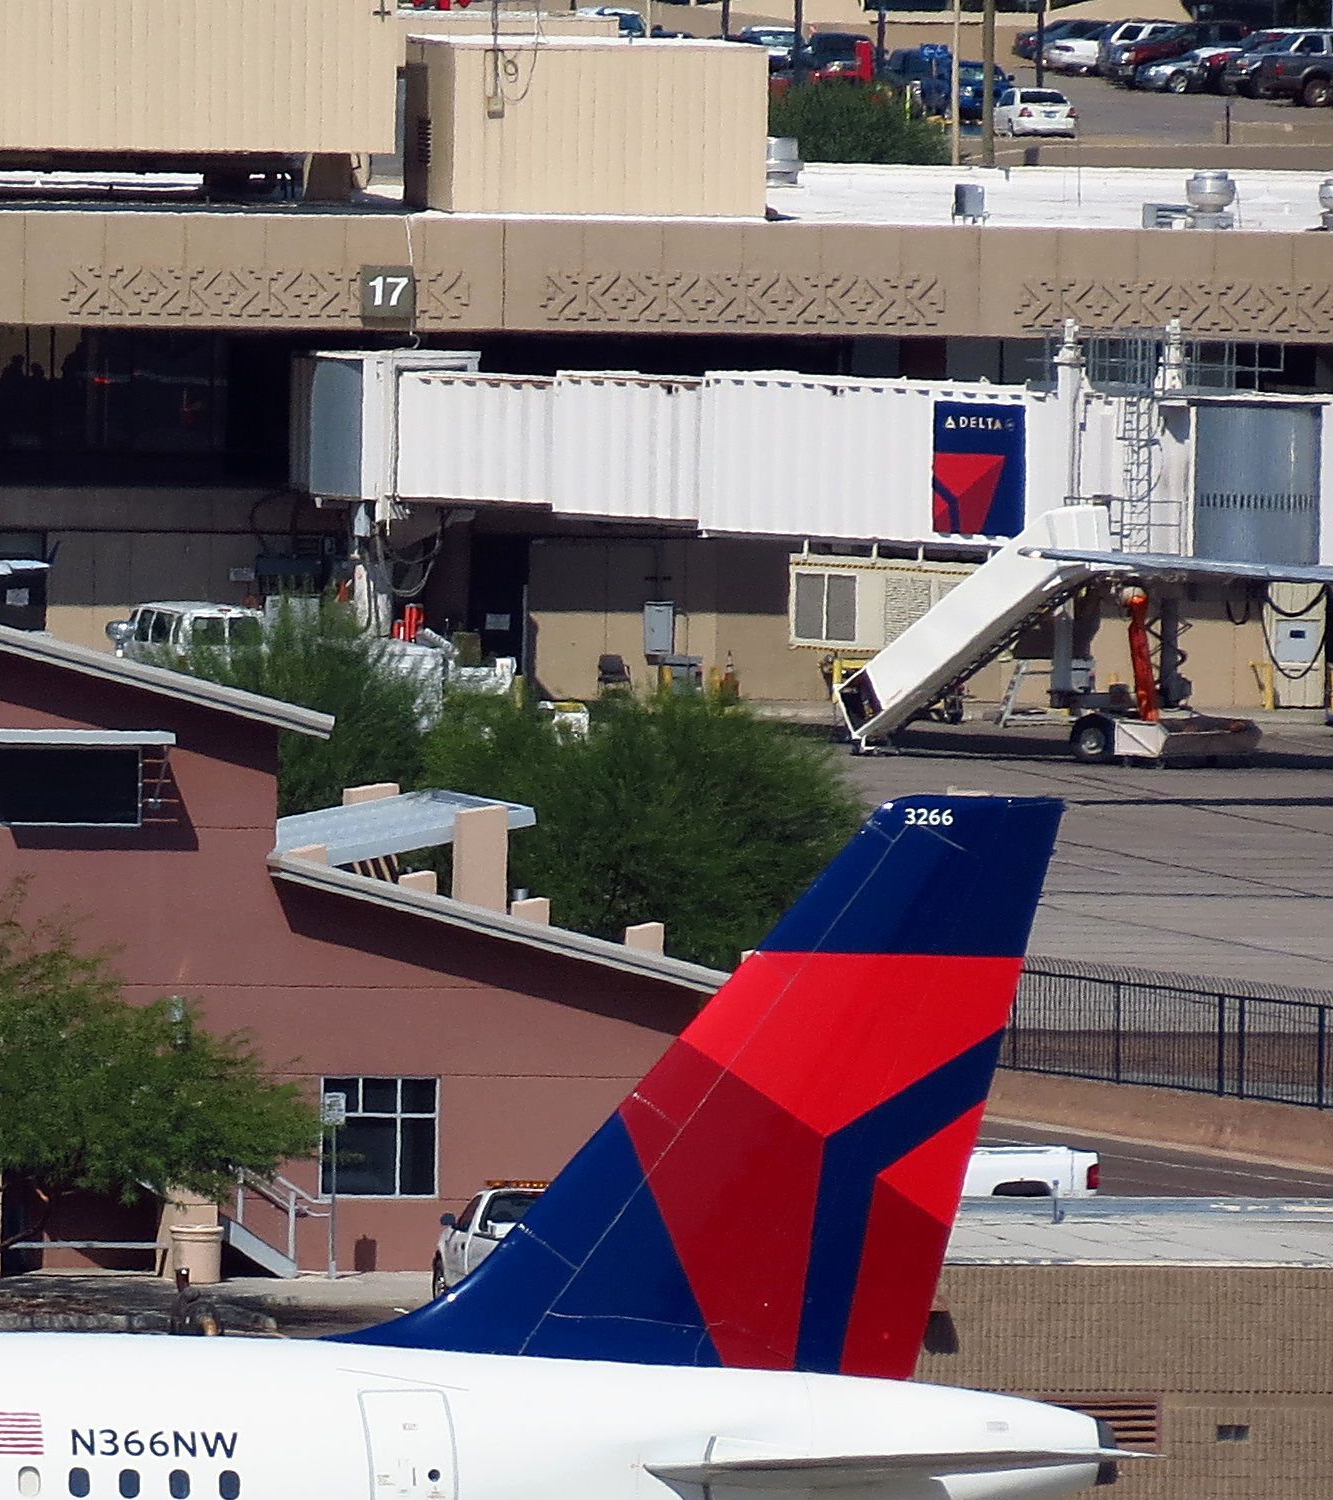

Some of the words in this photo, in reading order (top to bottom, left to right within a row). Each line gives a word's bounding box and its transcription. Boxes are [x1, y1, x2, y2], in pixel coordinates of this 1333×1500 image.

[367, 275, 410, 307] 17
[959, 416, 1002, 430] DELTA
[904, 807, 954, 828] 3266
[71, 1428, 239, 1459] N366NW
